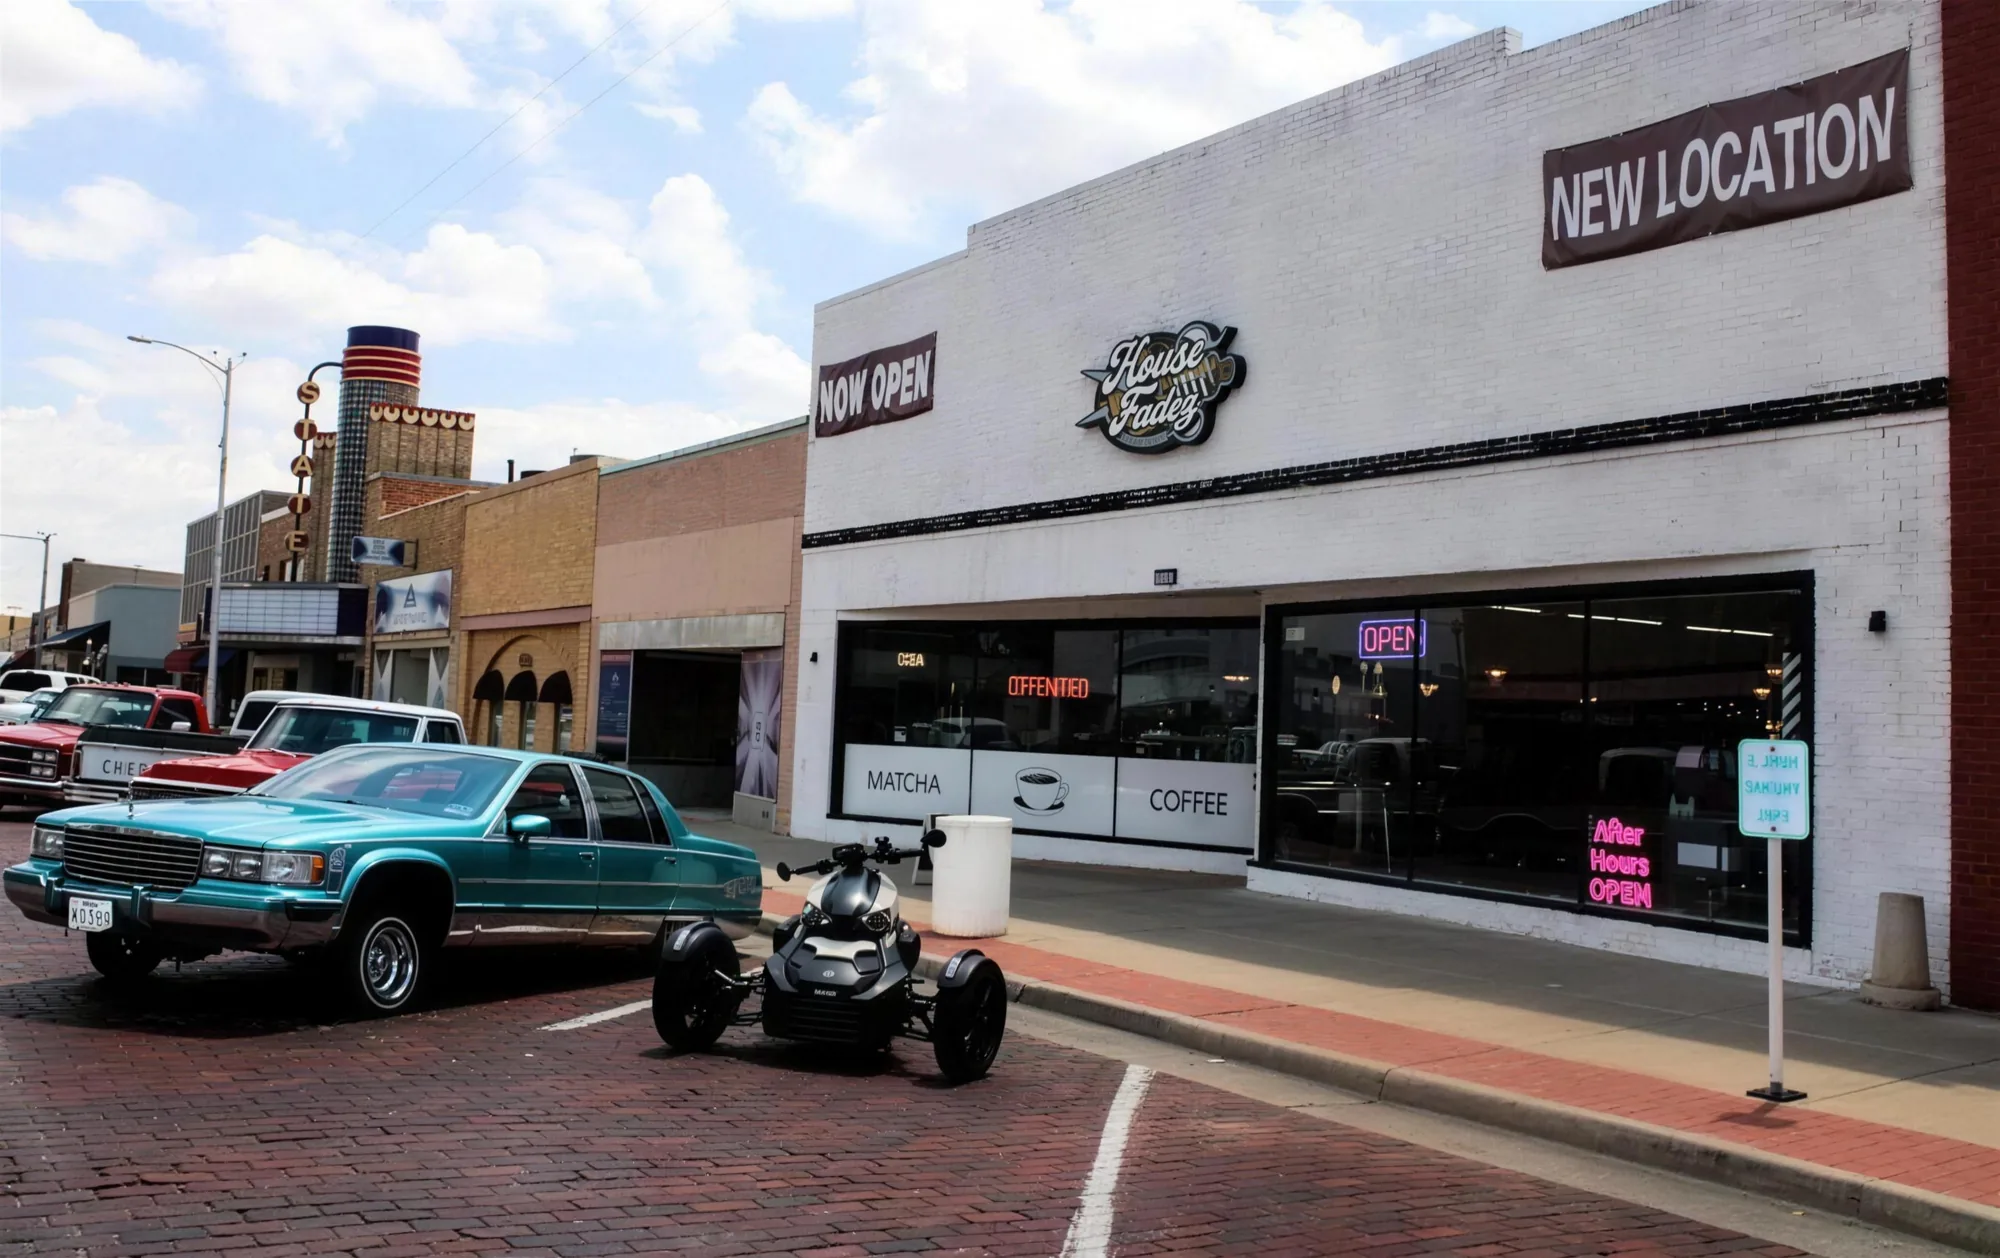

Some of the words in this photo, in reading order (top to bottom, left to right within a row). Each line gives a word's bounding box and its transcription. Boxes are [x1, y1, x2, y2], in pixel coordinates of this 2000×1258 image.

[1551, 157, 1646, 241] NEW
[1656, 87, 1896, 219] LOCATION
[1101, 335, 1206, 395] House
[820, 368, 868, 423] NOW
[871, 350, 932, 411] OPEN
[287, 380, 320, 552] STATE
[867, 770, 941, 795] MATCHA
[1150, 788, 1228, 816] COFFEE
[1593, 817, 1645, 847] After
[1590, 848, 1650, 877] Hours
[1589, 877, 1652, 909] OPEN
